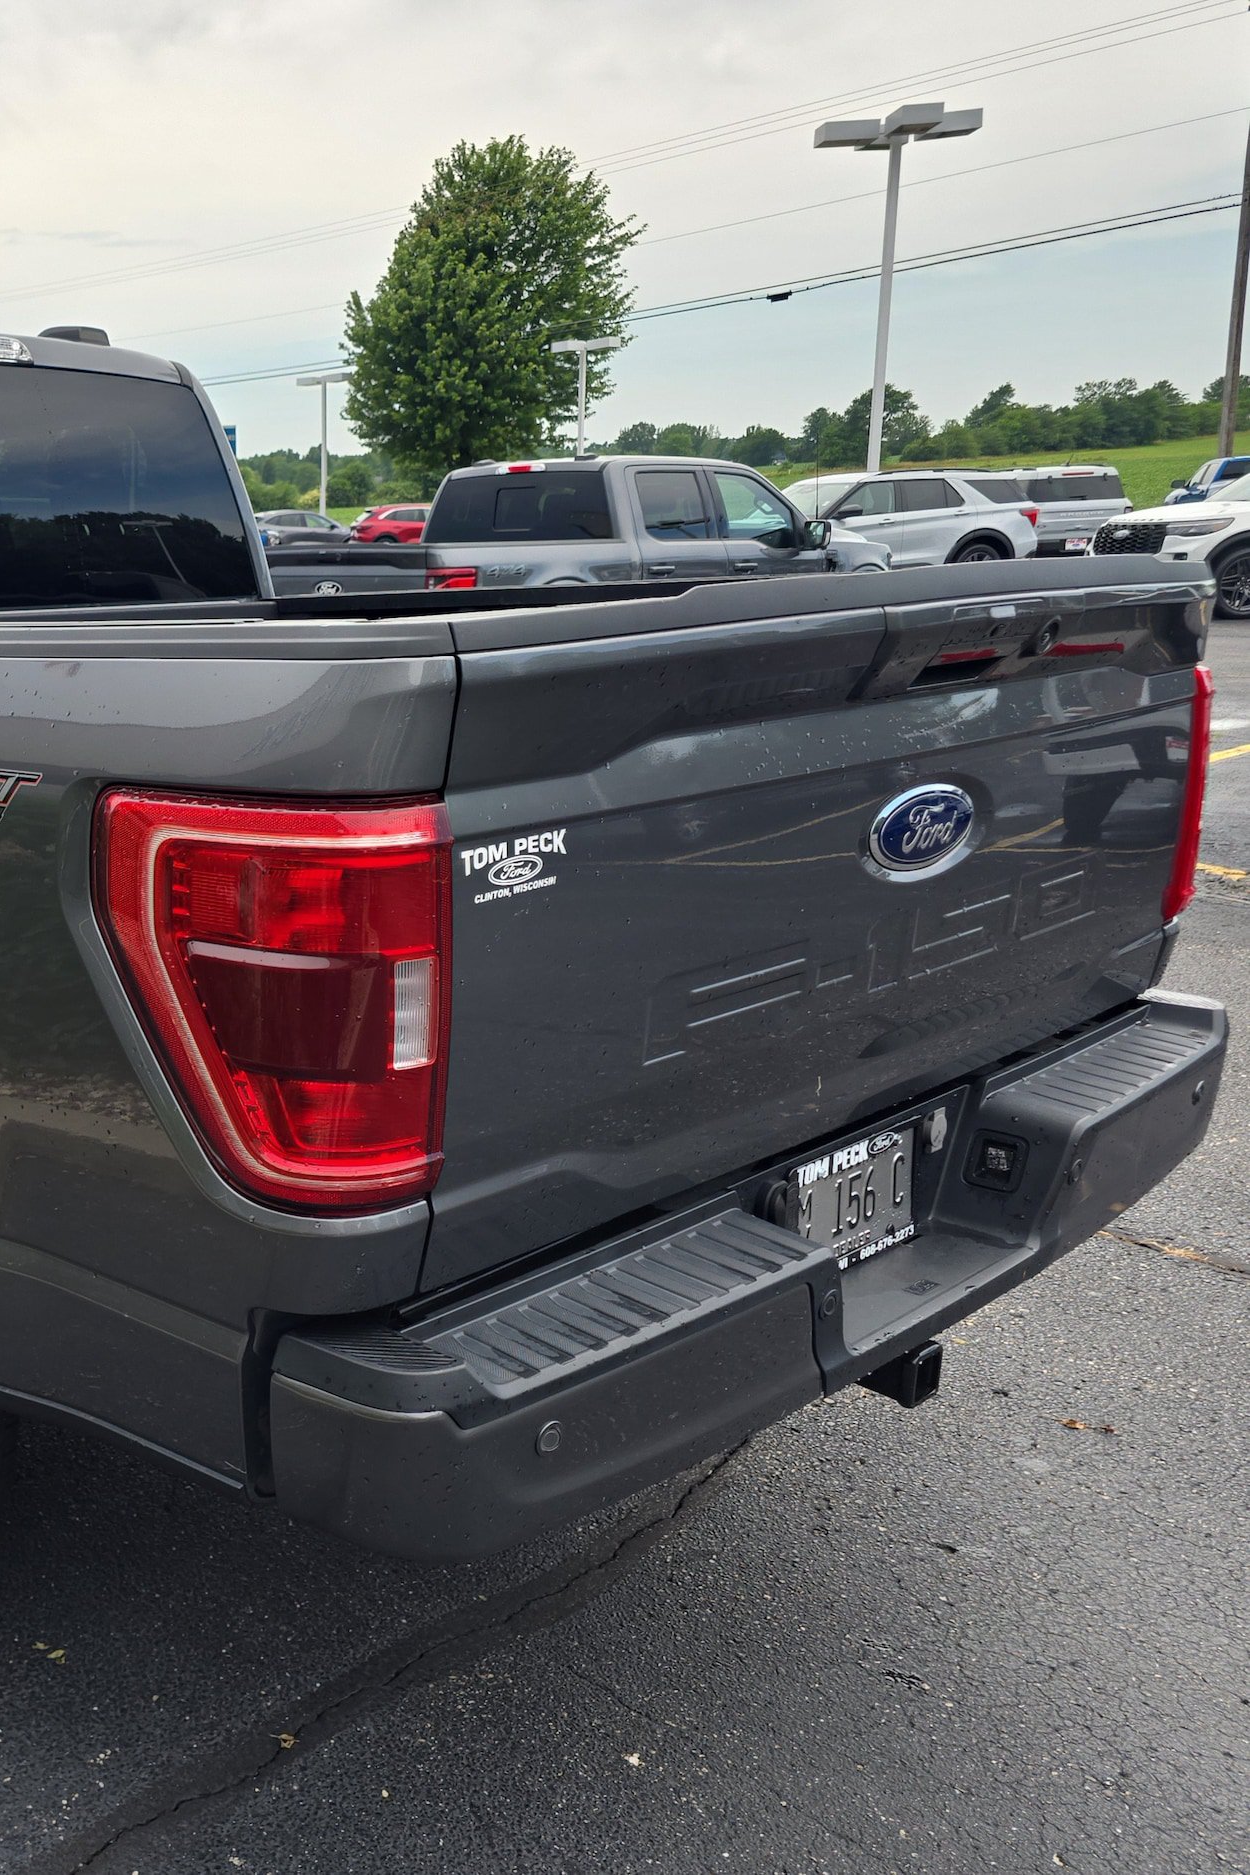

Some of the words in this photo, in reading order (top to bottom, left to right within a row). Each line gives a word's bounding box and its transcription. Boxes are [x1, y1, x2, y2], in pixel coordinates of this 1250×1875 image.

[461, 842, 508, 876] TOM
[514, 828, 567, 855] PECK
[901, 803, 958, 854] Ford
[474, 887, 512, 904] CLINTON,
[513, 875, 557, 895] WISCONSIN
[500, 861, 532, 880] Ford
[797, 1155, 830, 1187] TOM
[833, 1140, 869, 1174] PECK
[832, 1165, 876, 1237] 156
[860, 1224, 915, 1260] 608-676-2273
